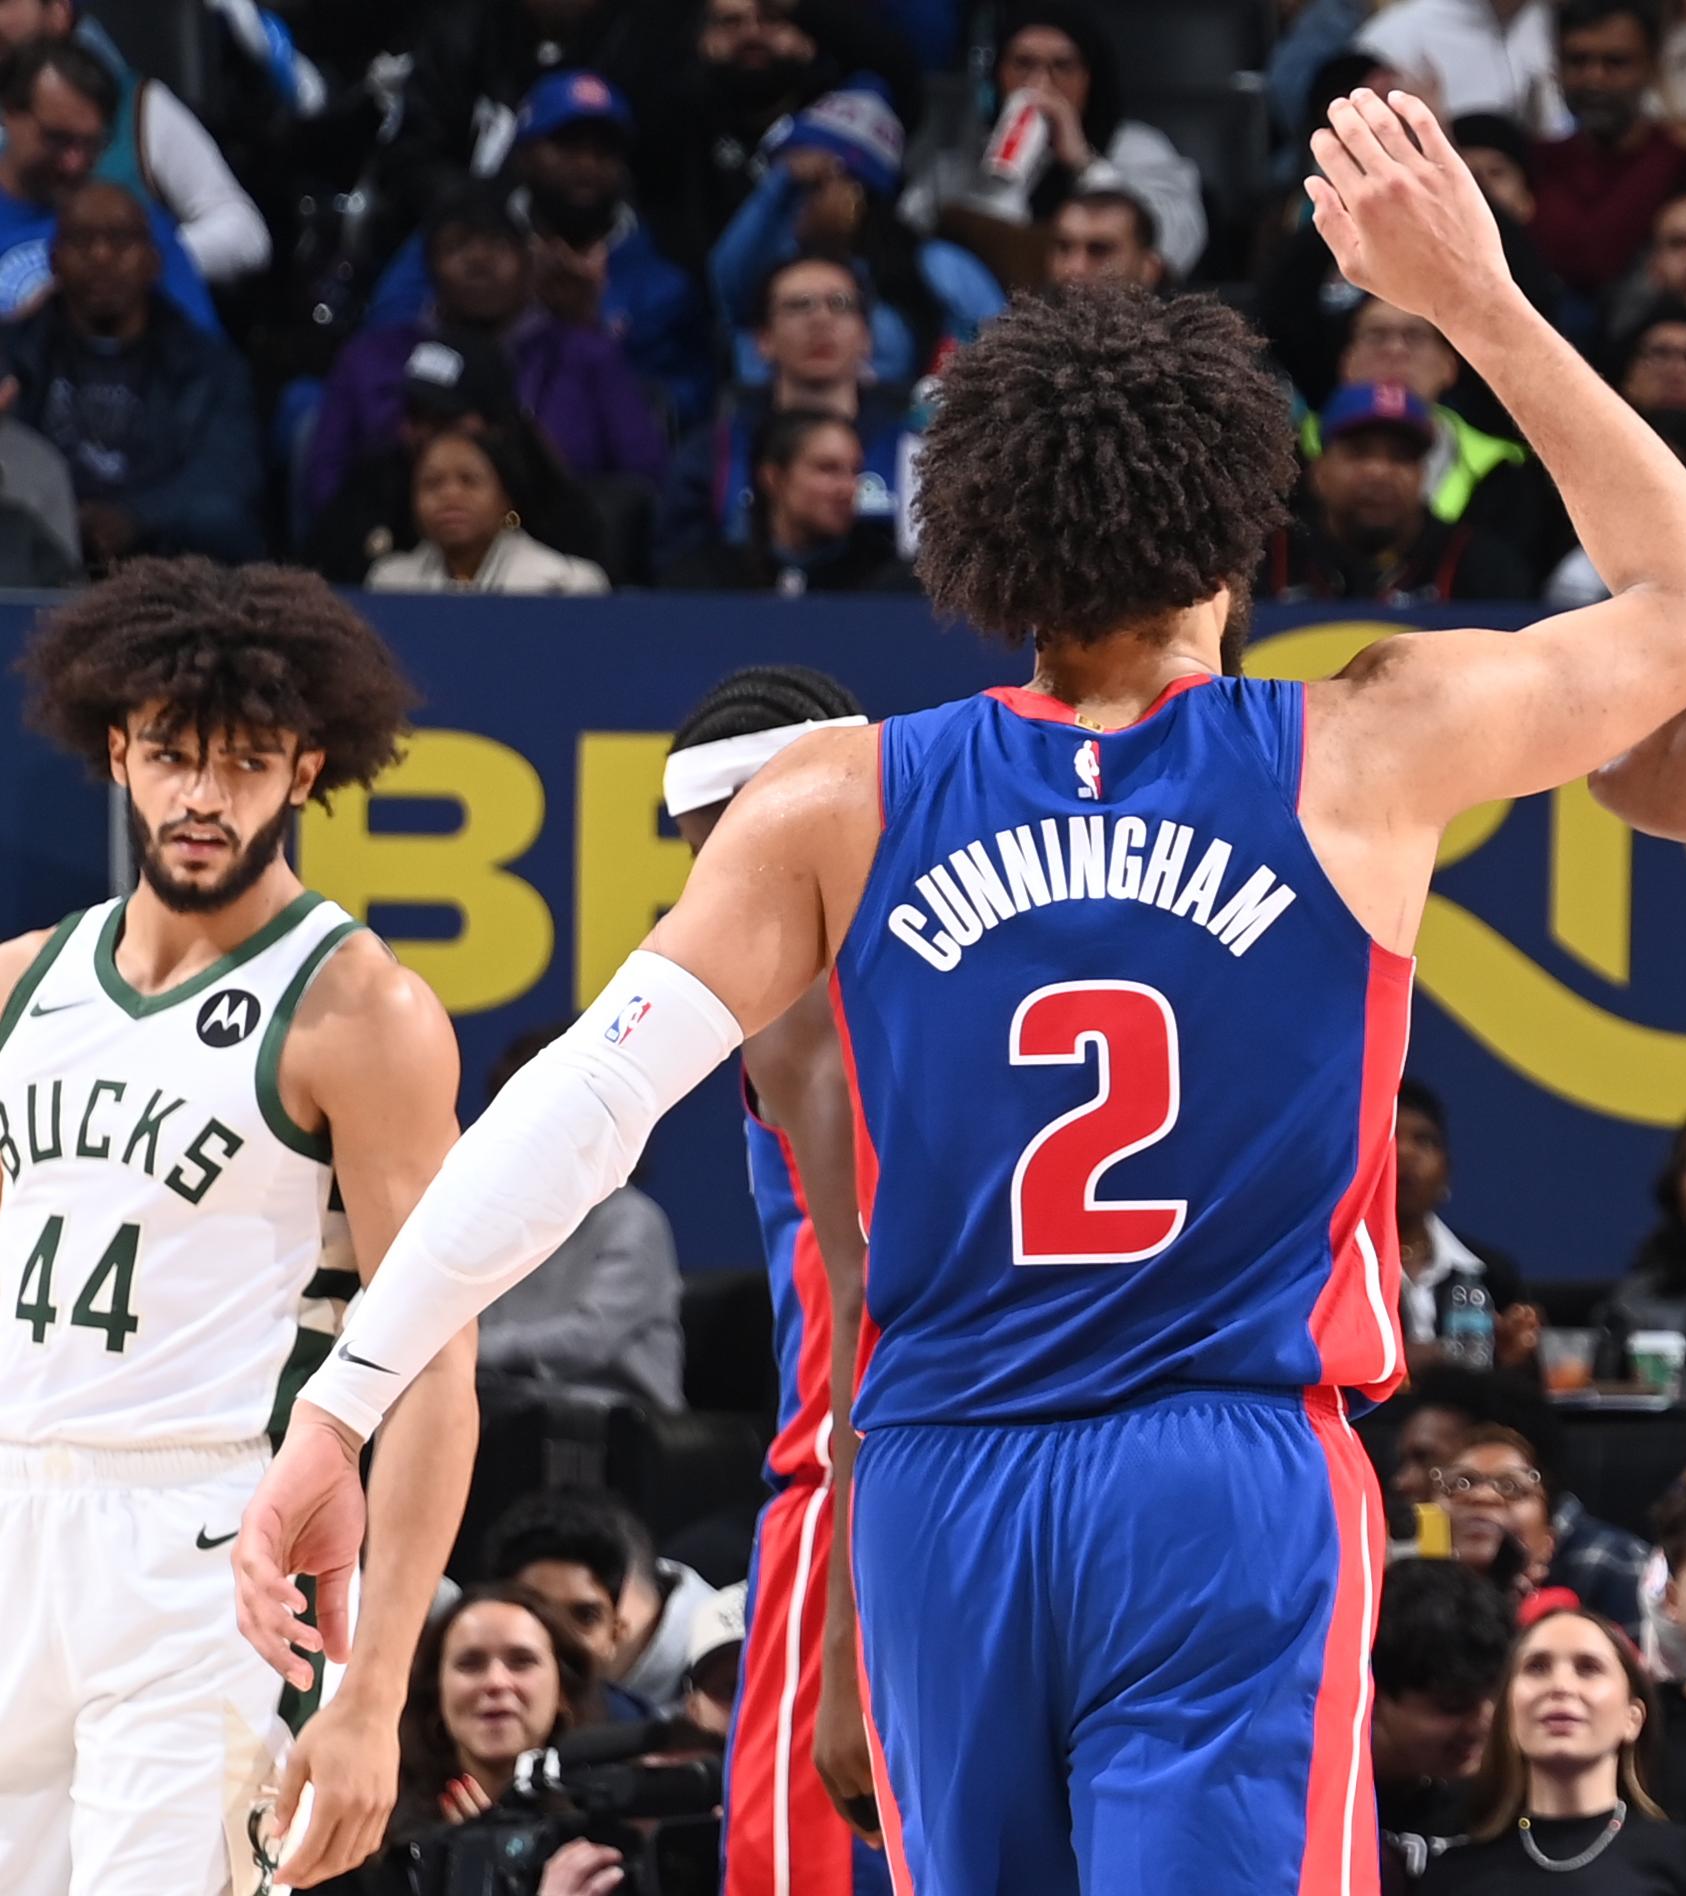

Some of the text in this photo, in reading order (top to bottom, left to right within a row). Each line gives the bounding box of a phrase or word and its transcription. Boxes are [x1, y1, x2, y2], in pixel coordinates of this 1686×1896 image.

[888, 815, 1297, 972] CUNNINGHAM
[1008, 980, 1188, 1266] 2
[15, 1214, 141, 1354] 44
